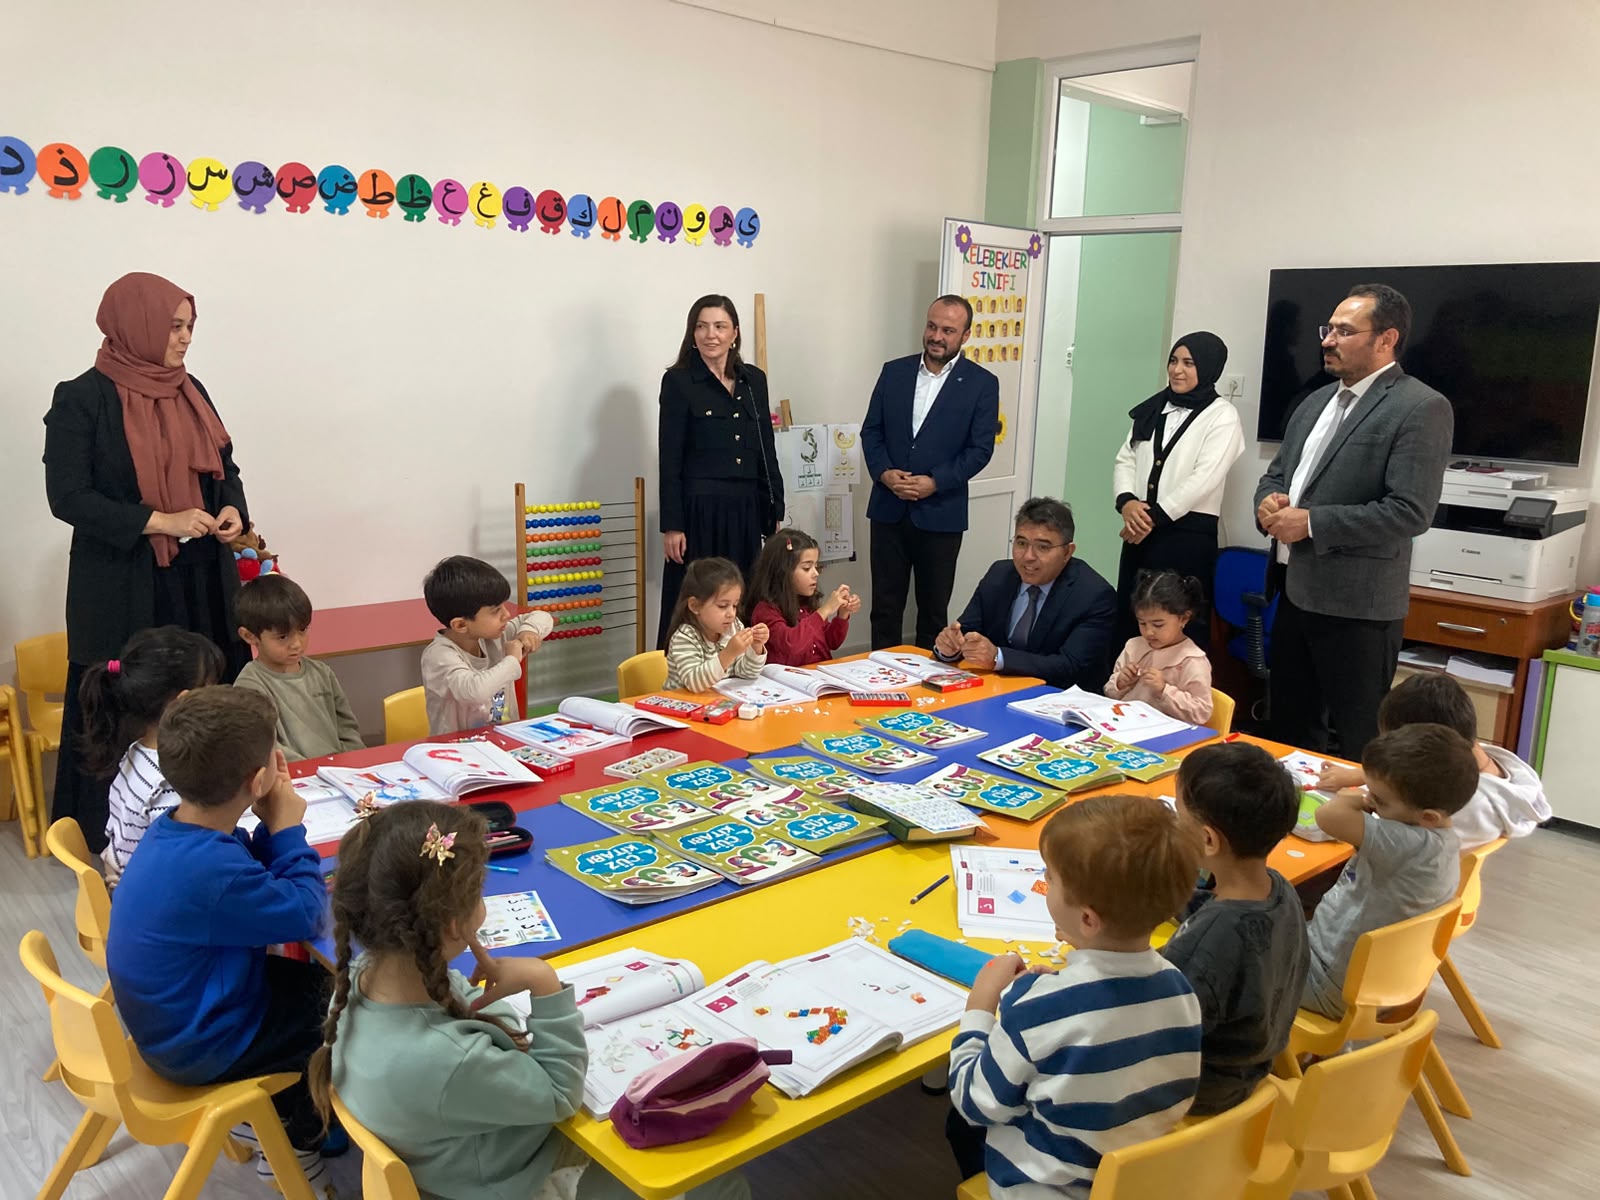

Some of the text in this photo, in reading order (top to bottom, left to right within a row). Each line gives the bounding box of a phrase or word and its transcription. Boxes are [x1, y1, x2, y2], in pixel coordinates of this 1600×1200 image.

[54, 149, 79, 186] ذ
[102, 154, 130, 188] ر
[149, 154, 176, 195] ز
[187, 166, 228, 191] س
[233, 166, 275, 196] ش
[276, 175, 316, 198] ص
[318, 173, 358, 200] ض
[361, 172, 395, 205] ط
[399, 175, 432, 209] ظ
[441, 182, 462, 215] ع
[477, 182, 496, 218] غ
[506, 192, 532, 216] ف
[540, 197, 564, 223] ق
[571, 196, 593, 227] ك
[603, 199, 621, 233] ل
[635, 203, 651, 236] م
[660, 207, 679, 231] ن
[687, 211, 706, 233] و
[963, 244, 1027, 270] KELEBEKLER
[971, 271, 1016, 292] SINIFI
[604, 854, 642, 870] CÜZ
